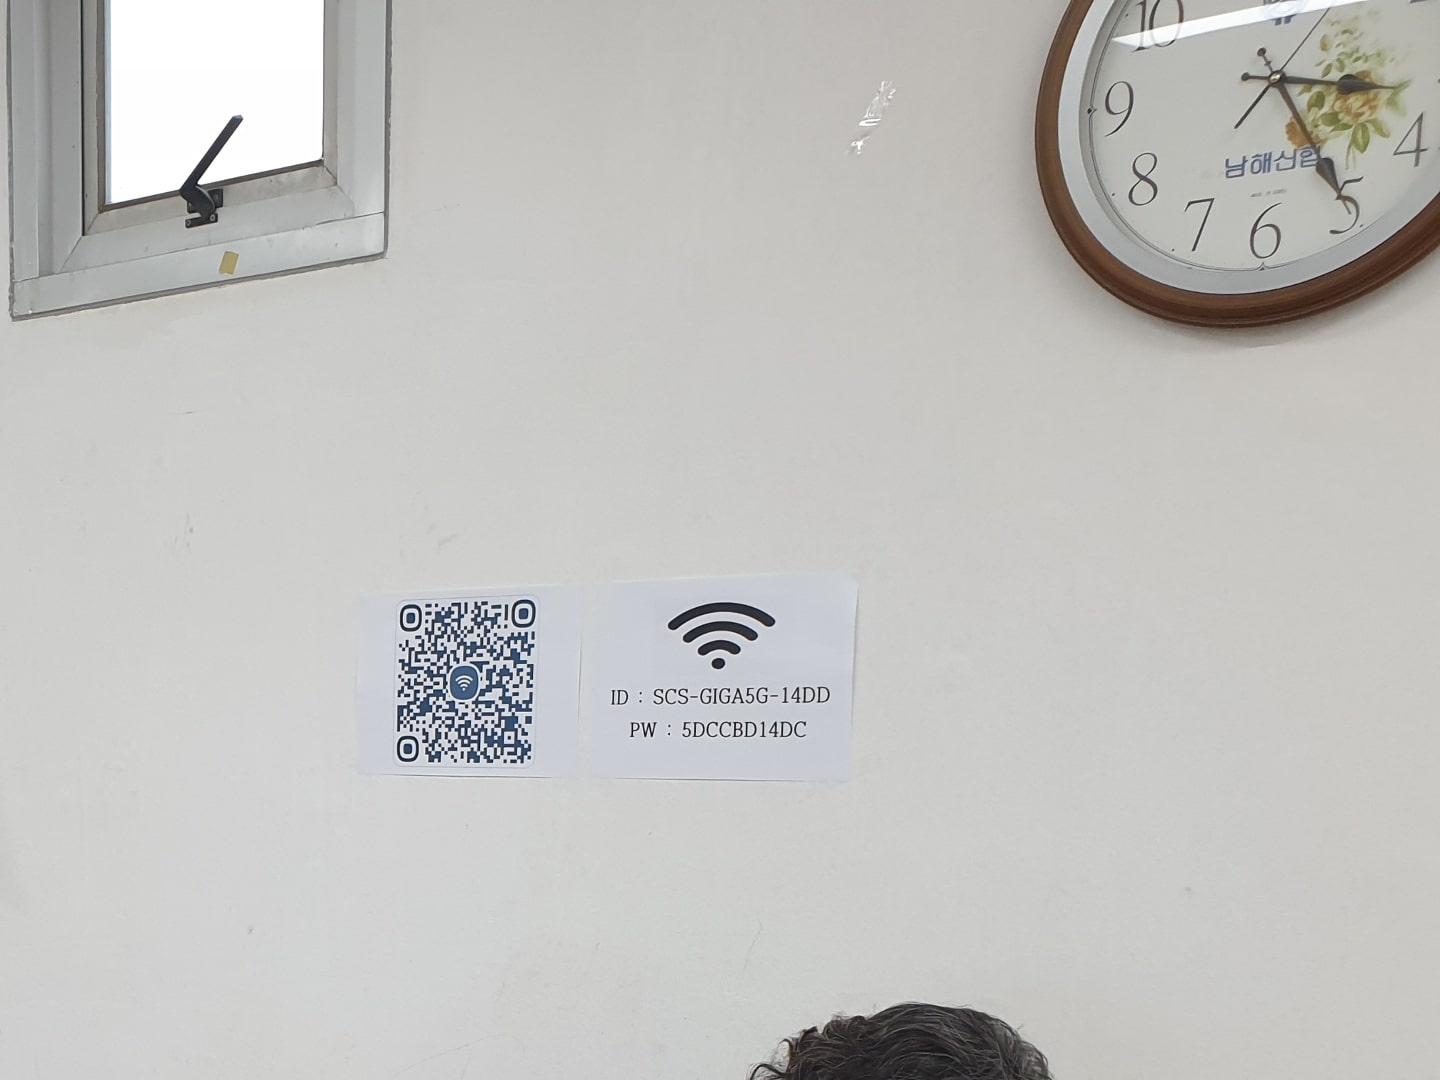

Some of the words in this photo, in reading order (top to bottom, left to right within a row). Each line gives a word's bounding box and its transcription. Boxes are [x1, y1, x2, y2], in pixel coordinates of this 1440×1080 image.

[1132, 0, 1184, 52] 10
[1105, 81, 1134, 137] 9
[1393, 112, 1428, 167] 4
[1128, 153, 1158, 206] 8
[1329, 176, 1363, 234] 5
[1184, 198, 1214, 251] 7
[1250, 202, 1282, 258] 6
[610, 689, 629, 705] ID
[653, 687, 831, 705] SCS-GIGA5G-14DD
[630, 722, 657, 738] PW
[681, 721, 807, 738] 5DCCBD14DC
